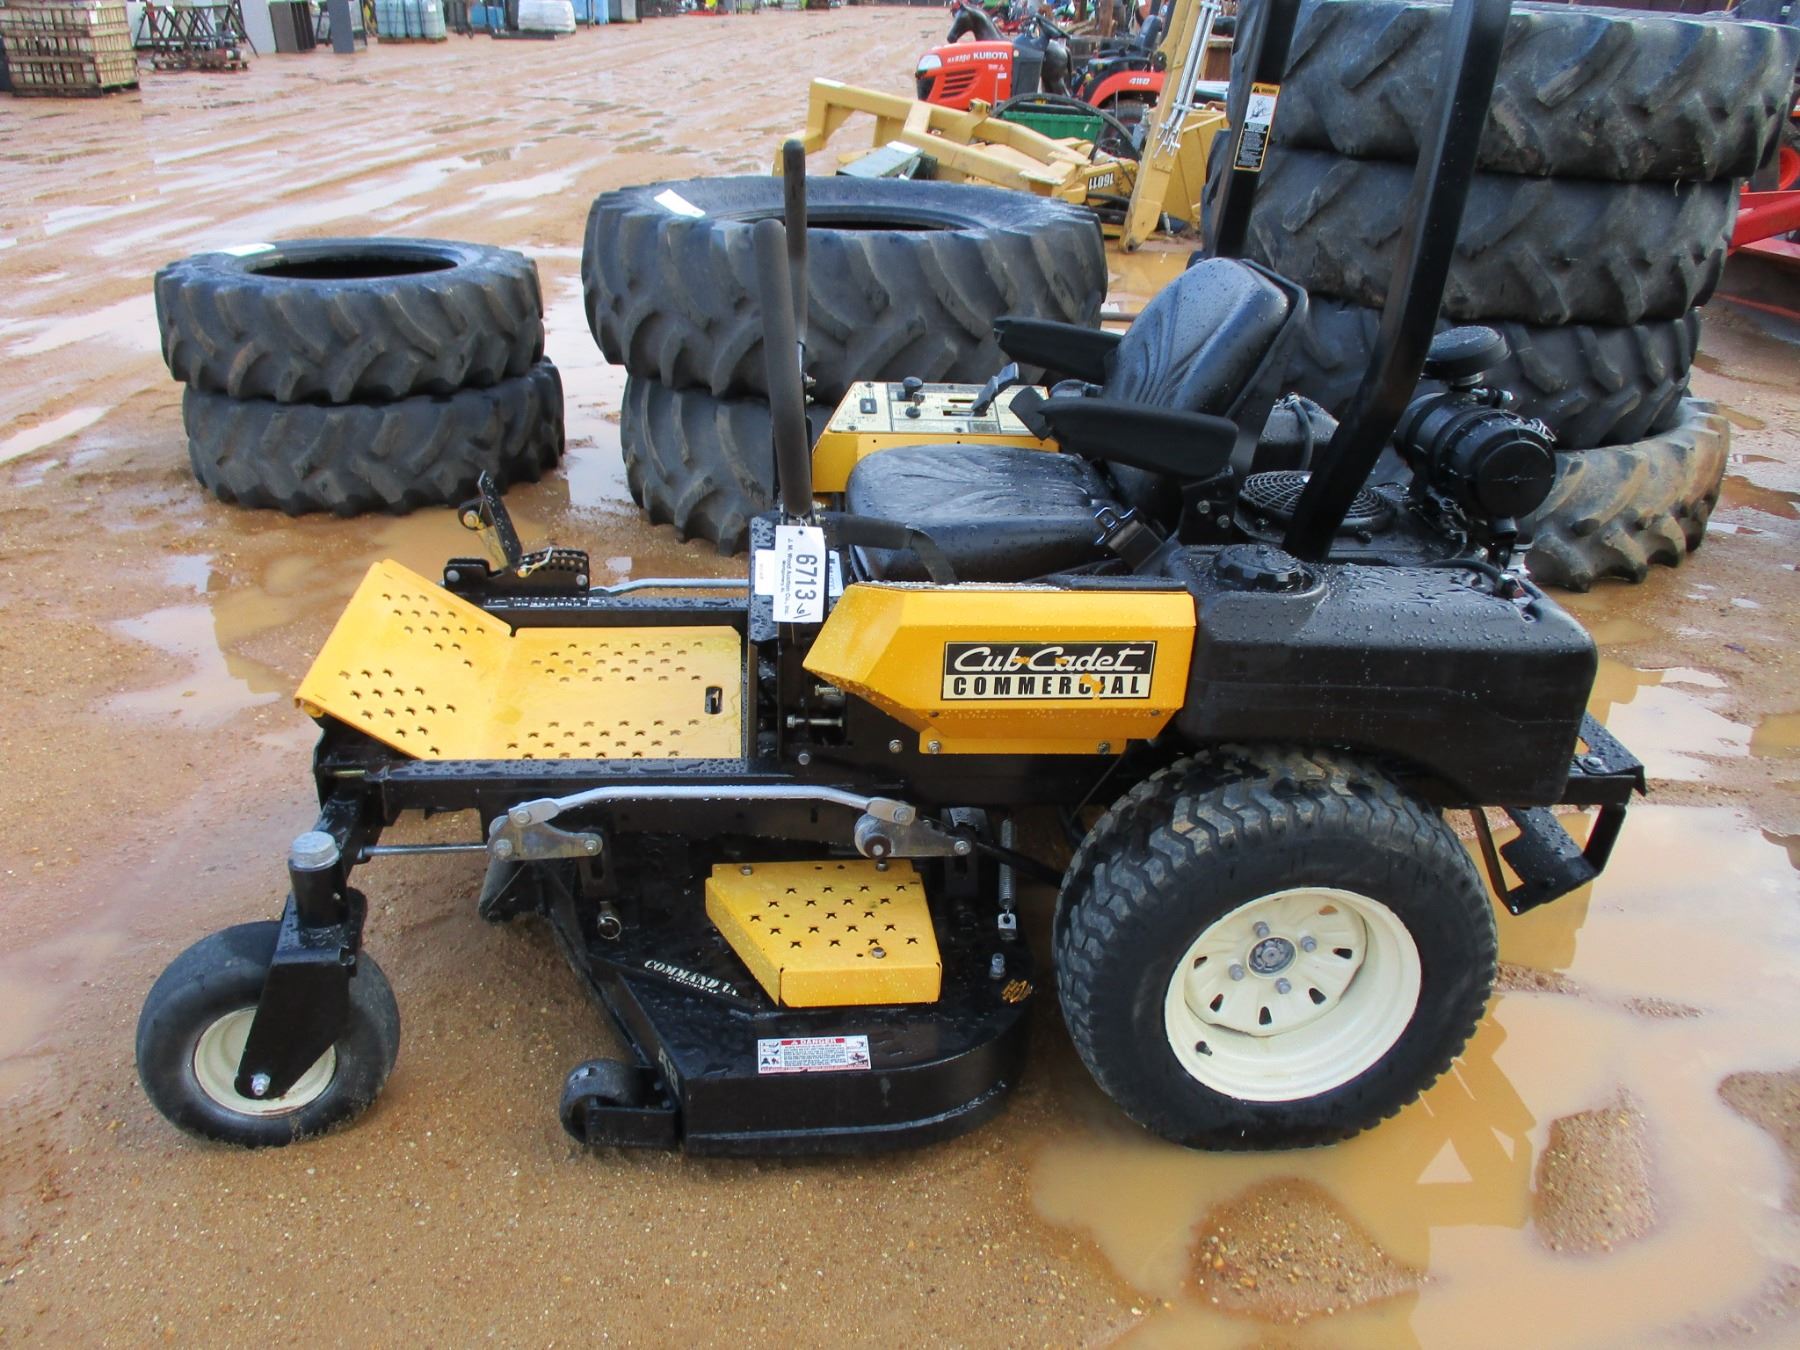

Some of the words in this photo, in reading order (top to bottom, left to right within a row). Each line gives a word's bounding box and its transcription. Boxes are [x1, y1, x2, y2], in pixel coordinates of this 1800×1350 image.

[973, 51, 1008, 60] KUBOTA
[795, 554, 818, 601] 6713
[954, 647, 1022, 672] Cub
[1026, 646, 1146, 672] Cadet
[953, 676, 1140, 696] COMMERCAL
[644, 960, 721, 988] COMMAND
